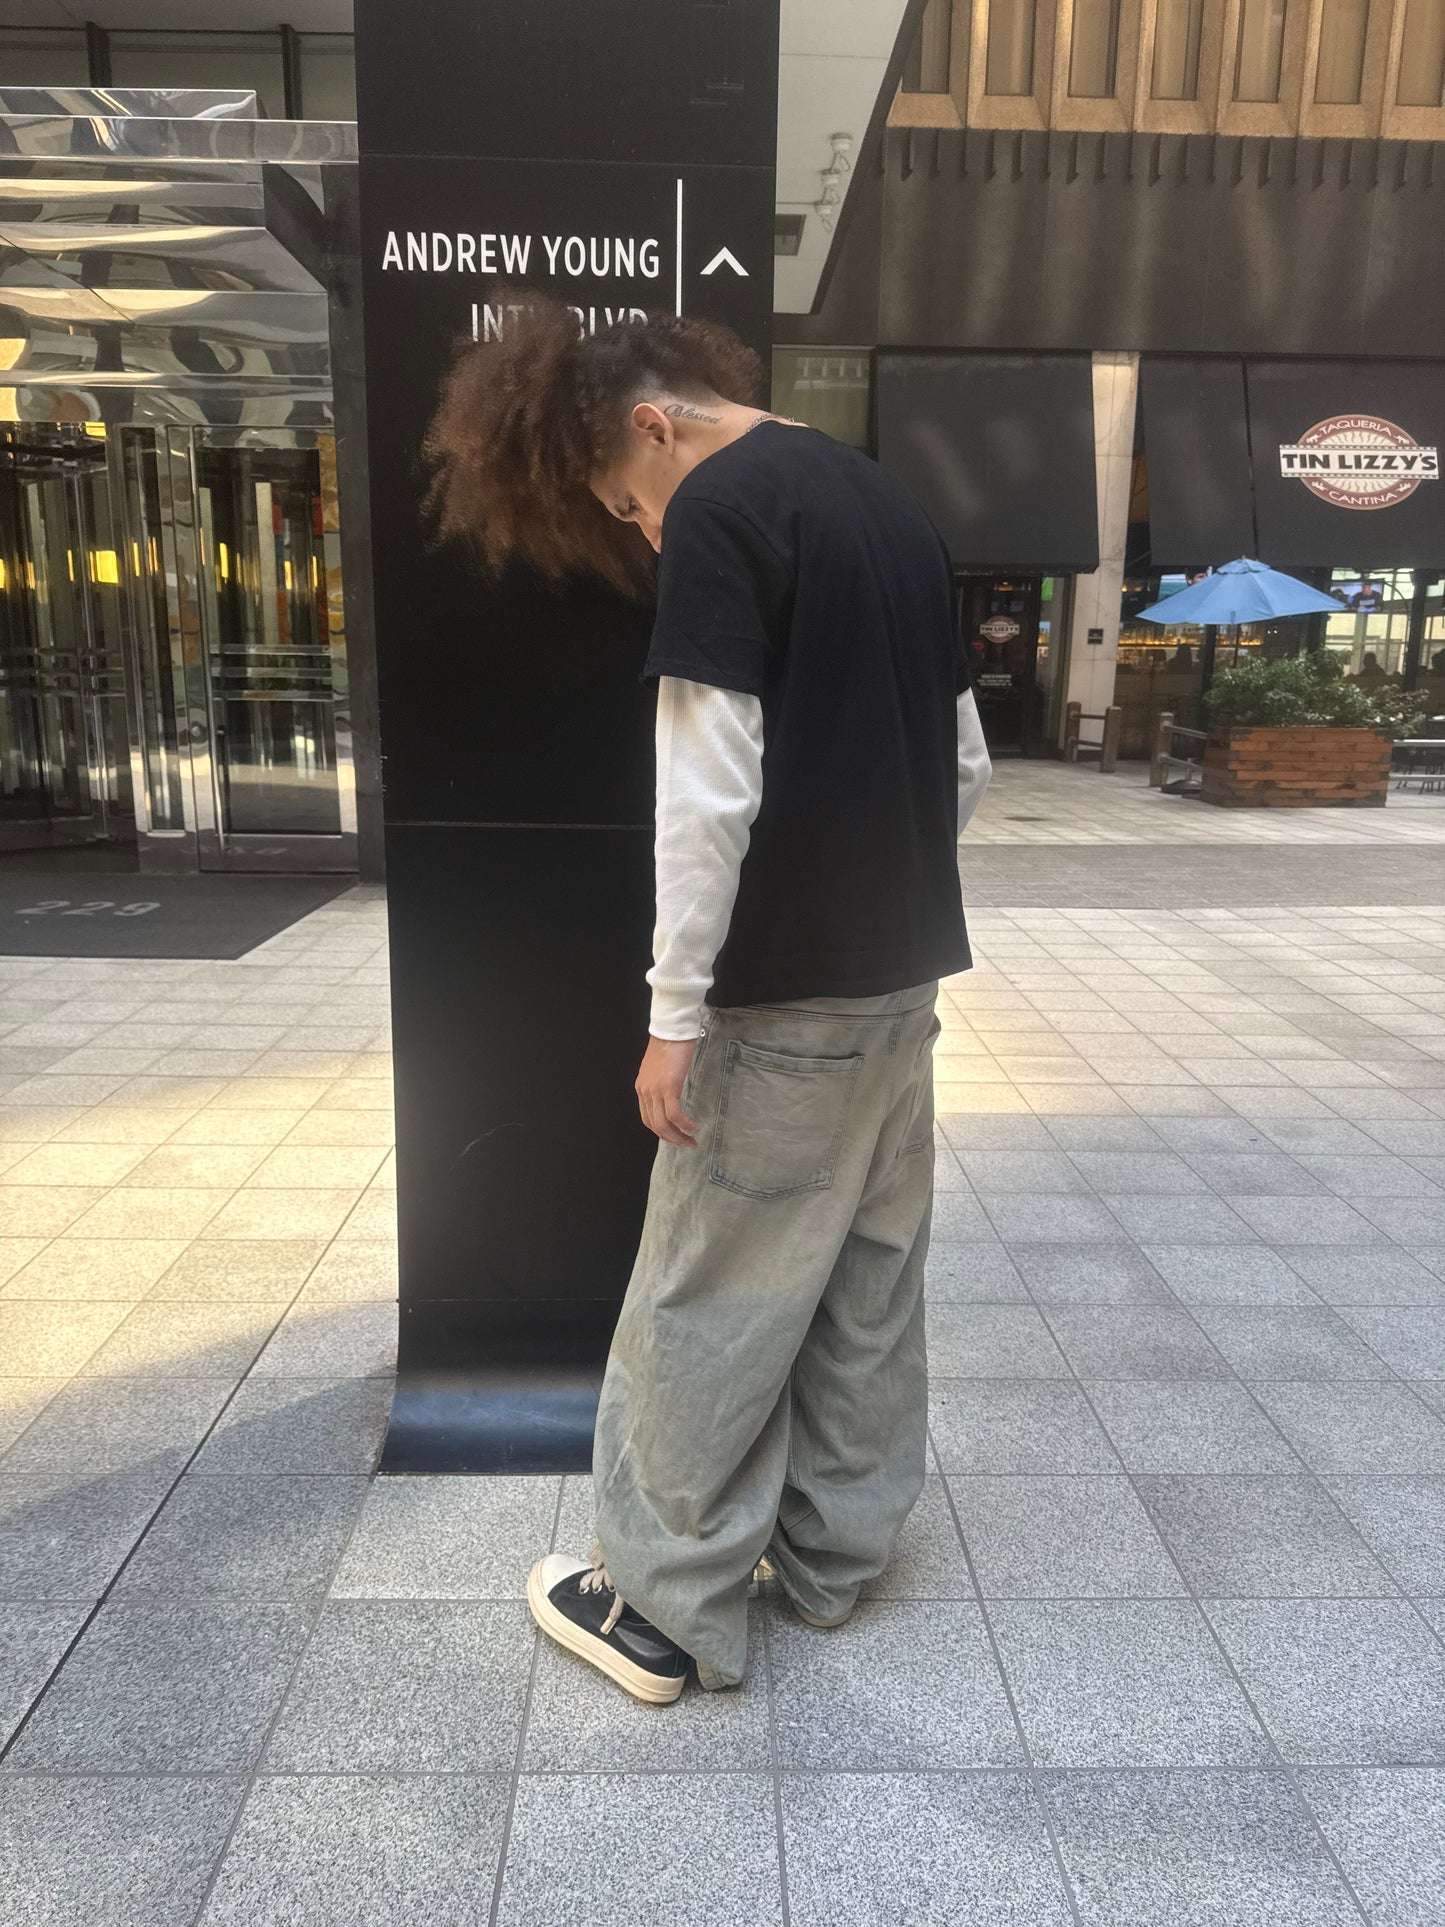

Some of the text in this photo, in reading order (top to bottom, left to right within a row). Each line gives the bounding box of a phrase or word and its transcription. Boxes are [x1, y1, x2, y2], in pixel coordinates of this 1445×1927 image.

[381, 231, 660, 279] ANDREW YOUNG
[663, 403, 723, 425] Blessed
[1319, 419, 1393, 436] TAQUERIA
[1282, 453, 1437, 471] TIN LIZZY'S
[1328, 491, 1398, 506] CANTINA
[15, 899, 161, 917] 229
